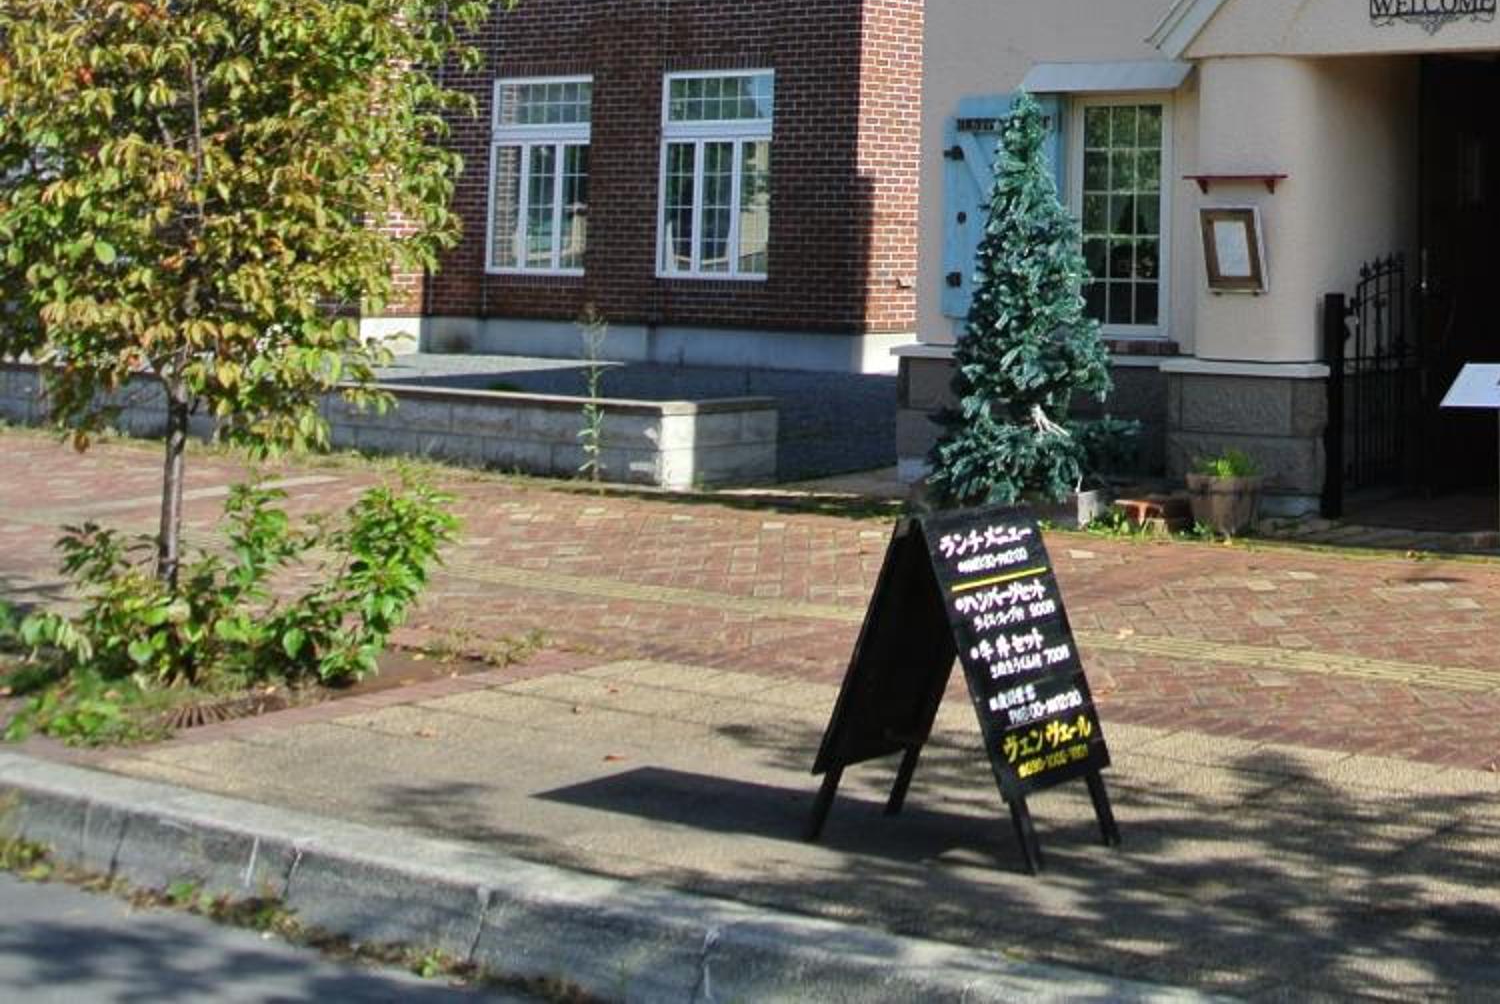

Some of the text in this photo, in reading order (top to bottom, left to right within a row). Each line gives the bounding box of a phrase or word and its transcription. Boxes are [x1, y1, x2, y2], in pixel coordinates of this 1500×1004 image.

[940, 526, 1032, 558] ランチメニュー
